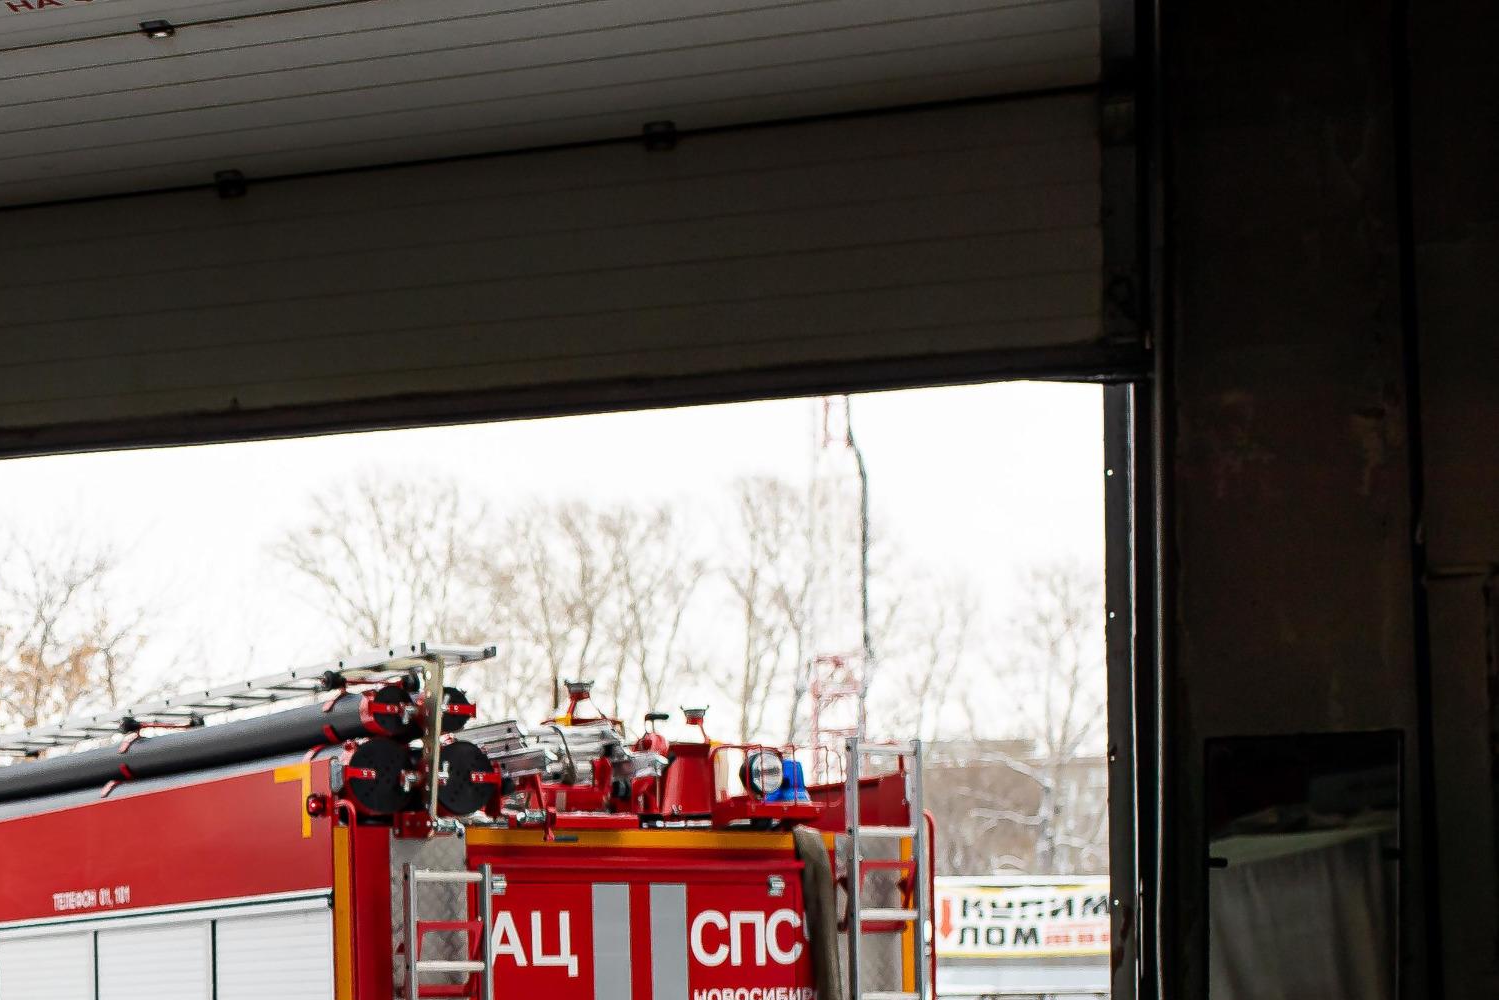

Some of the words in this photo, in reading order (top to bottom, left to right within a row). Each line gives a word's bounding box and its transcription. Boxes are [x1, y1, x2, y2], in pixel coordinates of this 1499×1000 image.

[491, 910, 579, 977] АЦ
[690, 908, 811, 967] СПС
[958, 926, 1040, 946] ЛОМ
